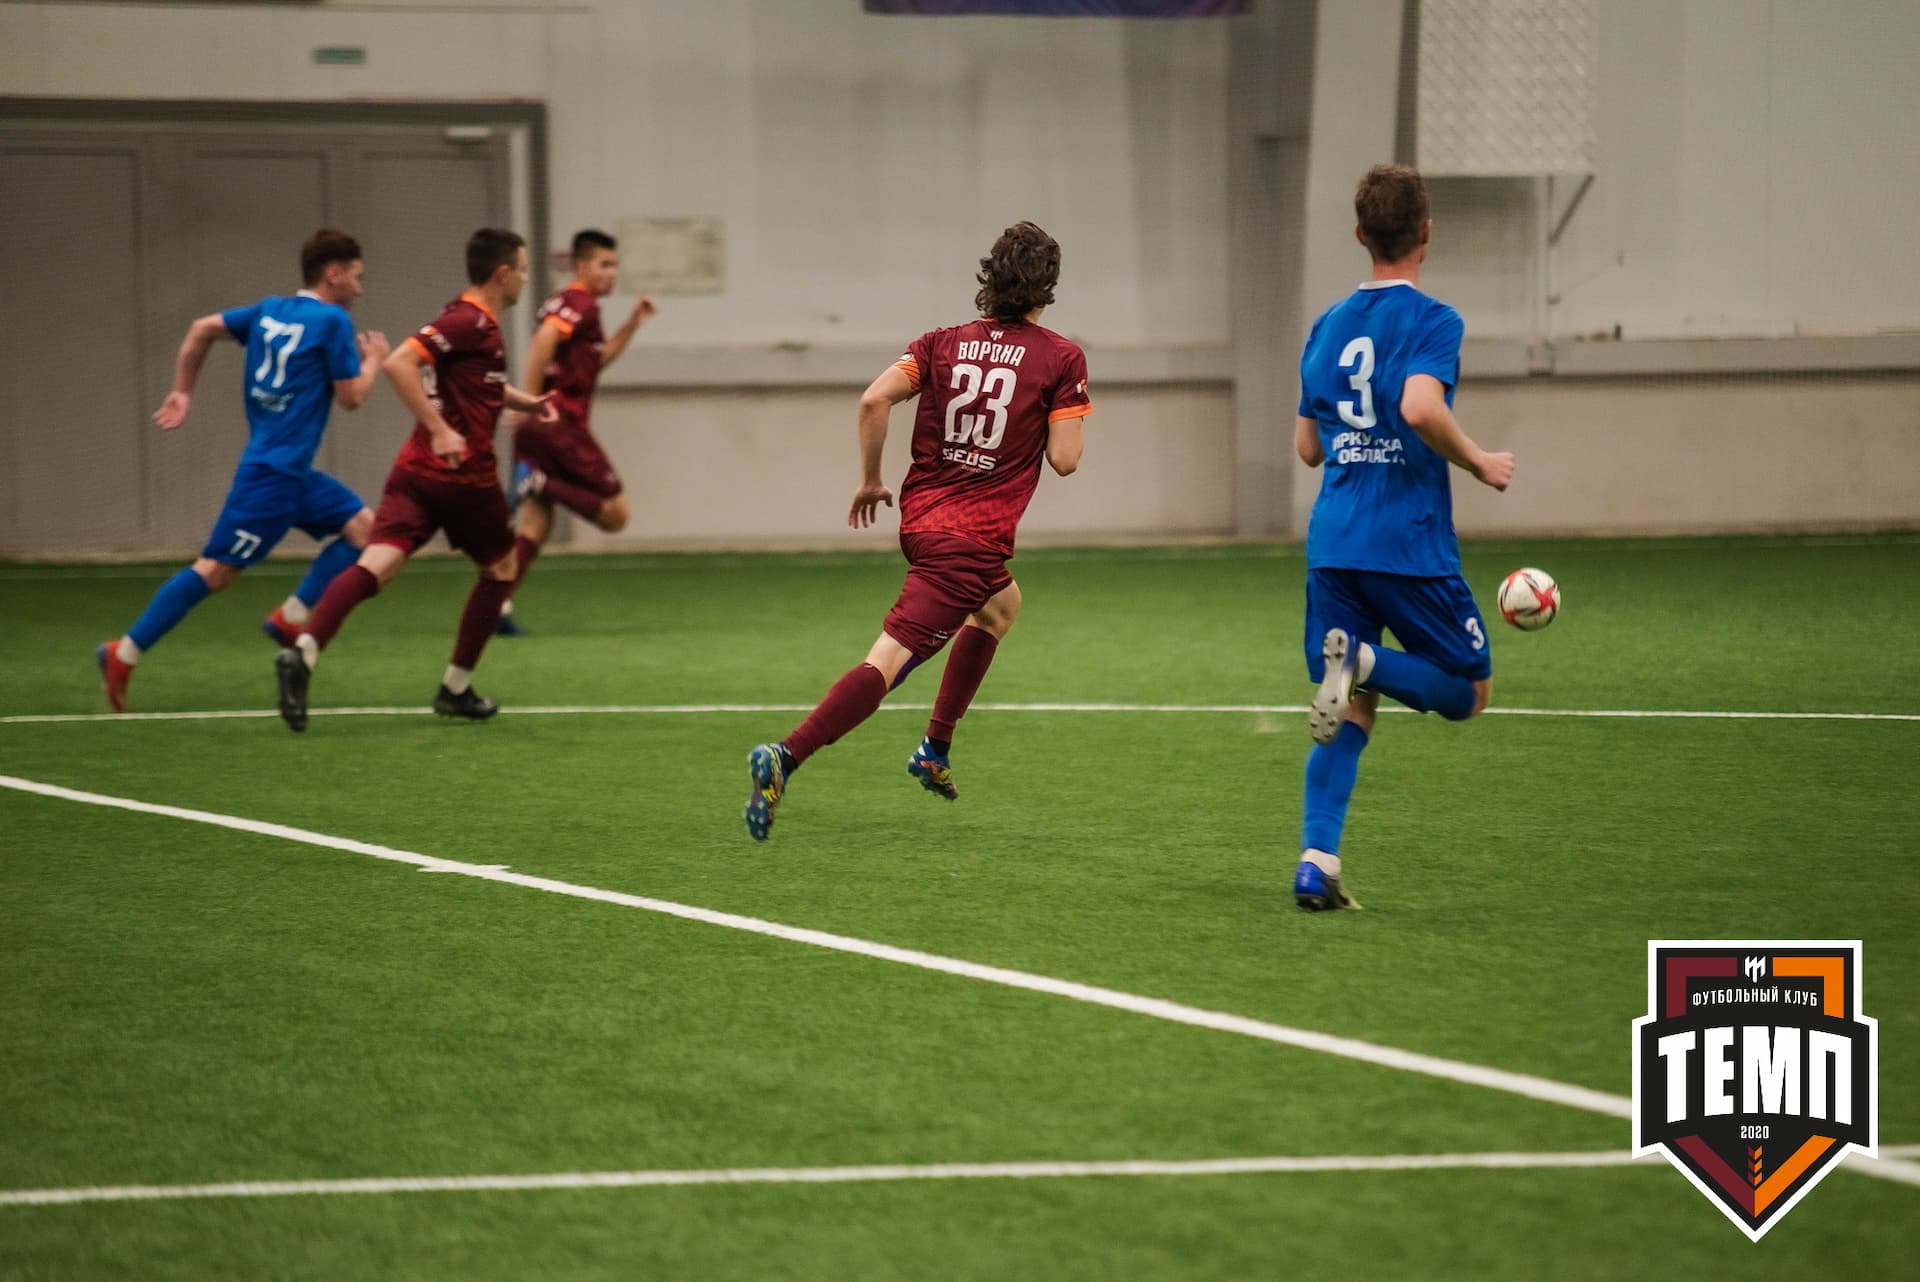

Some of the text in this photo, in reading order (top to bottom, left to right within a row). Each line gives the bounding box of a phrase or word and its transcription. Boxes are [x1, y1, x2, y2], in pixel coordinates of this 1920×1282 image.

[255, 316, 305, 389] 77
[957, 341, 1026, 367] ВОРОНА
[944, 363, 1017, 450] 23
[1336, 336, 1377, 430] 3
[230, 529, 262, 559] 77
[1465, 617, 1485, 650] 3
